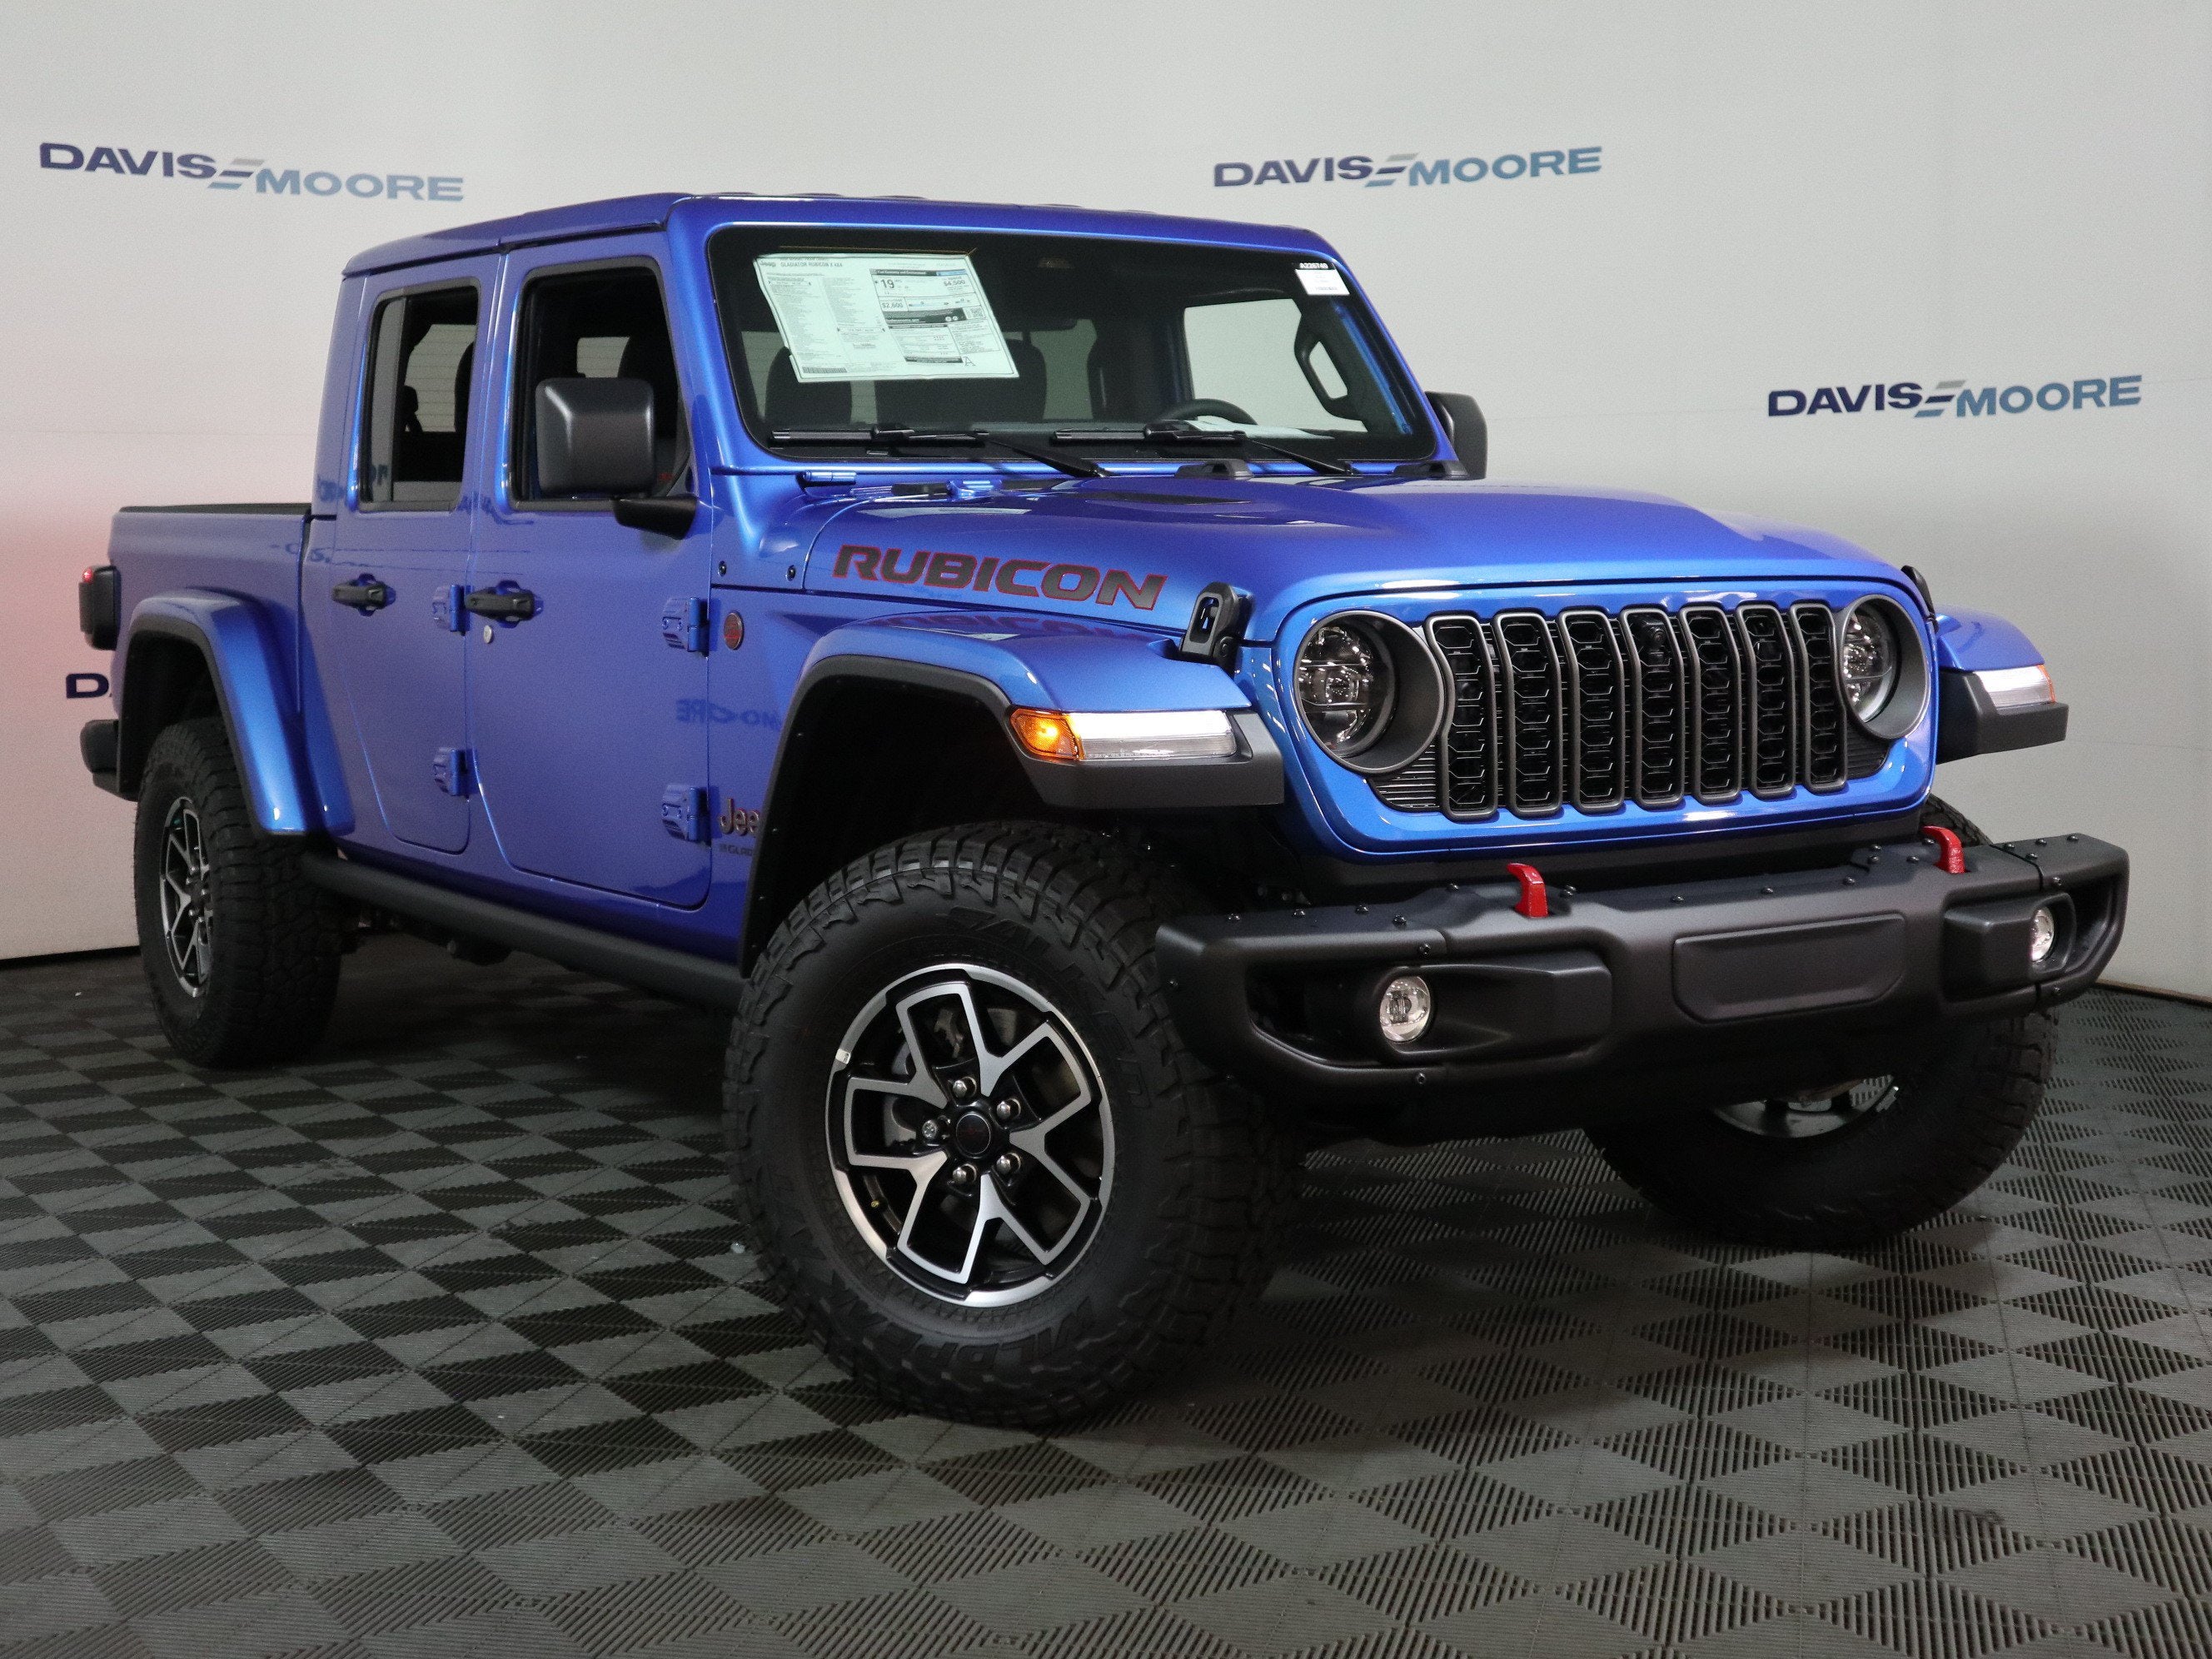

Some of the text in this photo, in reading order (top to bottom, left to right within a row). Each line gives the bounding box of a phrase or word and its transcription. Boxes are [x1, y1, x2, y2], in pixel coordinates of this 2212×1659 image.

[40, 142, 464, 202] DAVIS MOORE
[1213, 146, 1602, 187] DAVIS MOORE
[880, 278, 895, 289] 19
[1768, 375, 2143, 417] DAVIS MOORE
[833, 544, 1168, 611] RUBICON
[720, 797, 760, 836] Jee
